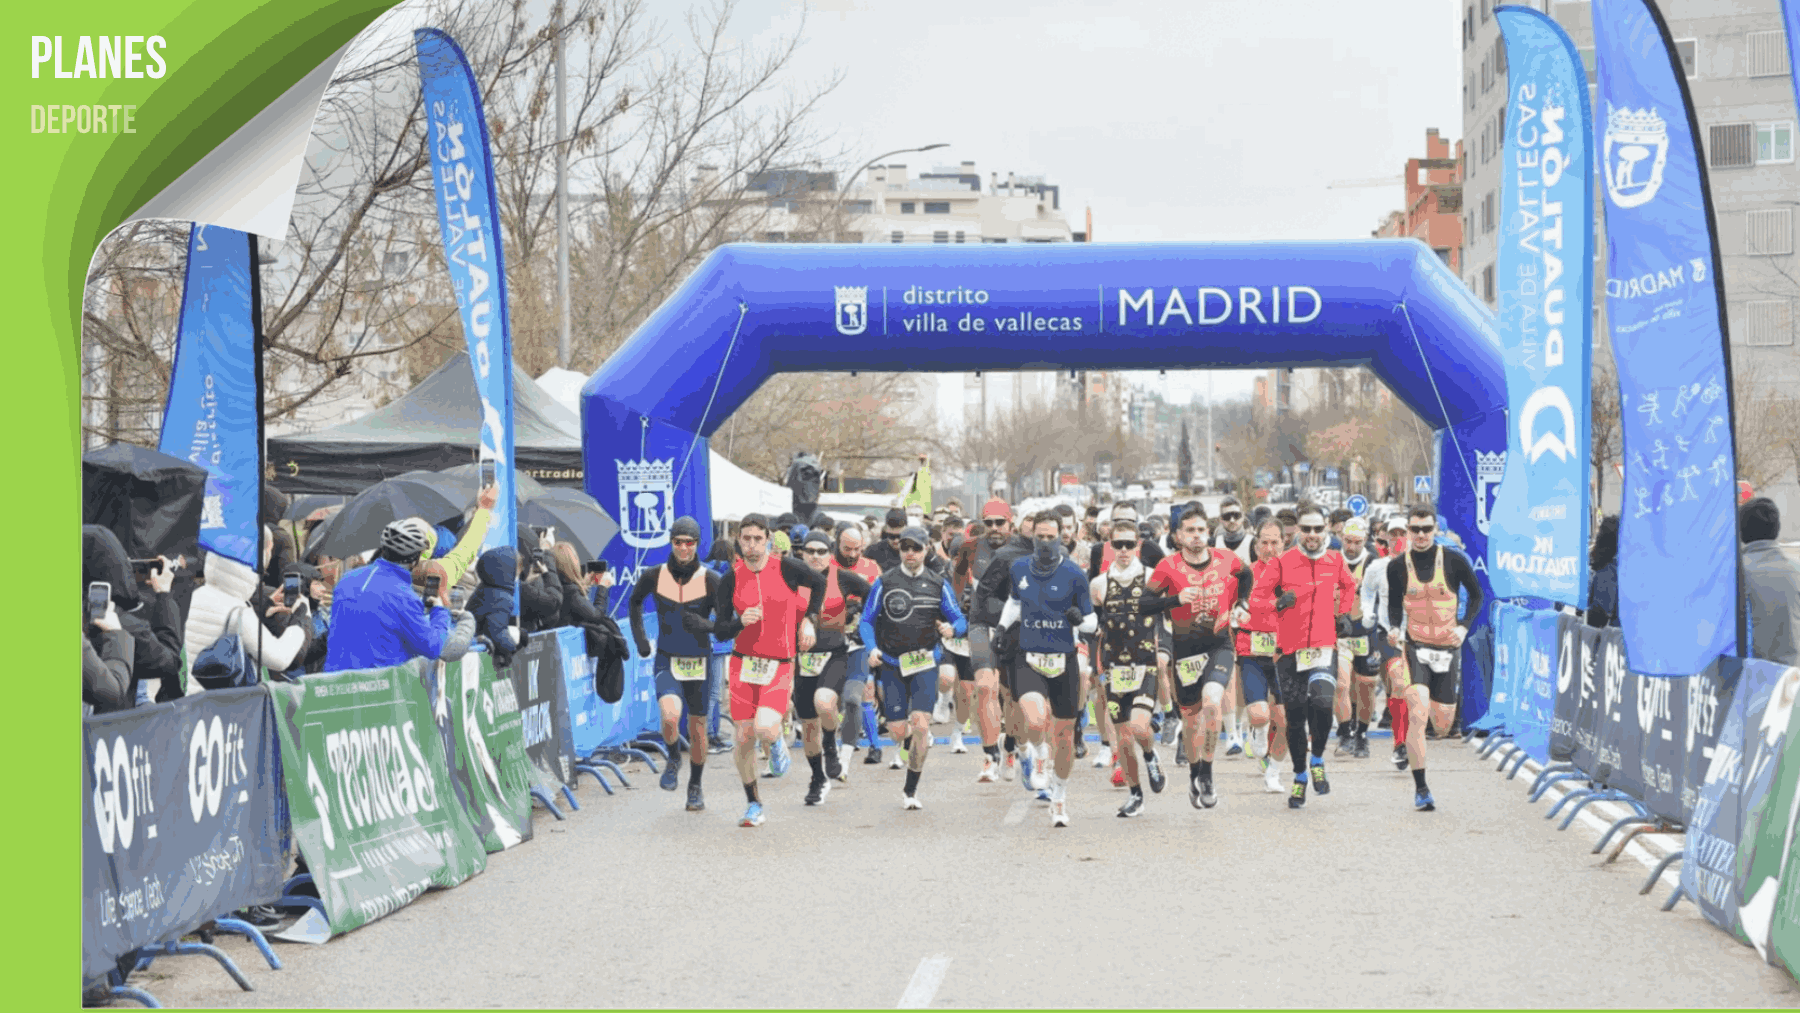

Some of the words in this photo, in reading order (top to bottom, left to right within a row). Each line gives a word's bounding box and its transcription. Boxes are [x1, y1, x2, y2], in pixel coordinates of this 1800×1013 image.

[903, 285, 989, 305] distrito
[1118, 286, 1322, 326] MADRID
[903, 311, 948, 333] villa
[957, 312, 986, 333] de
[995, 311, 1083, 333] vallecas
